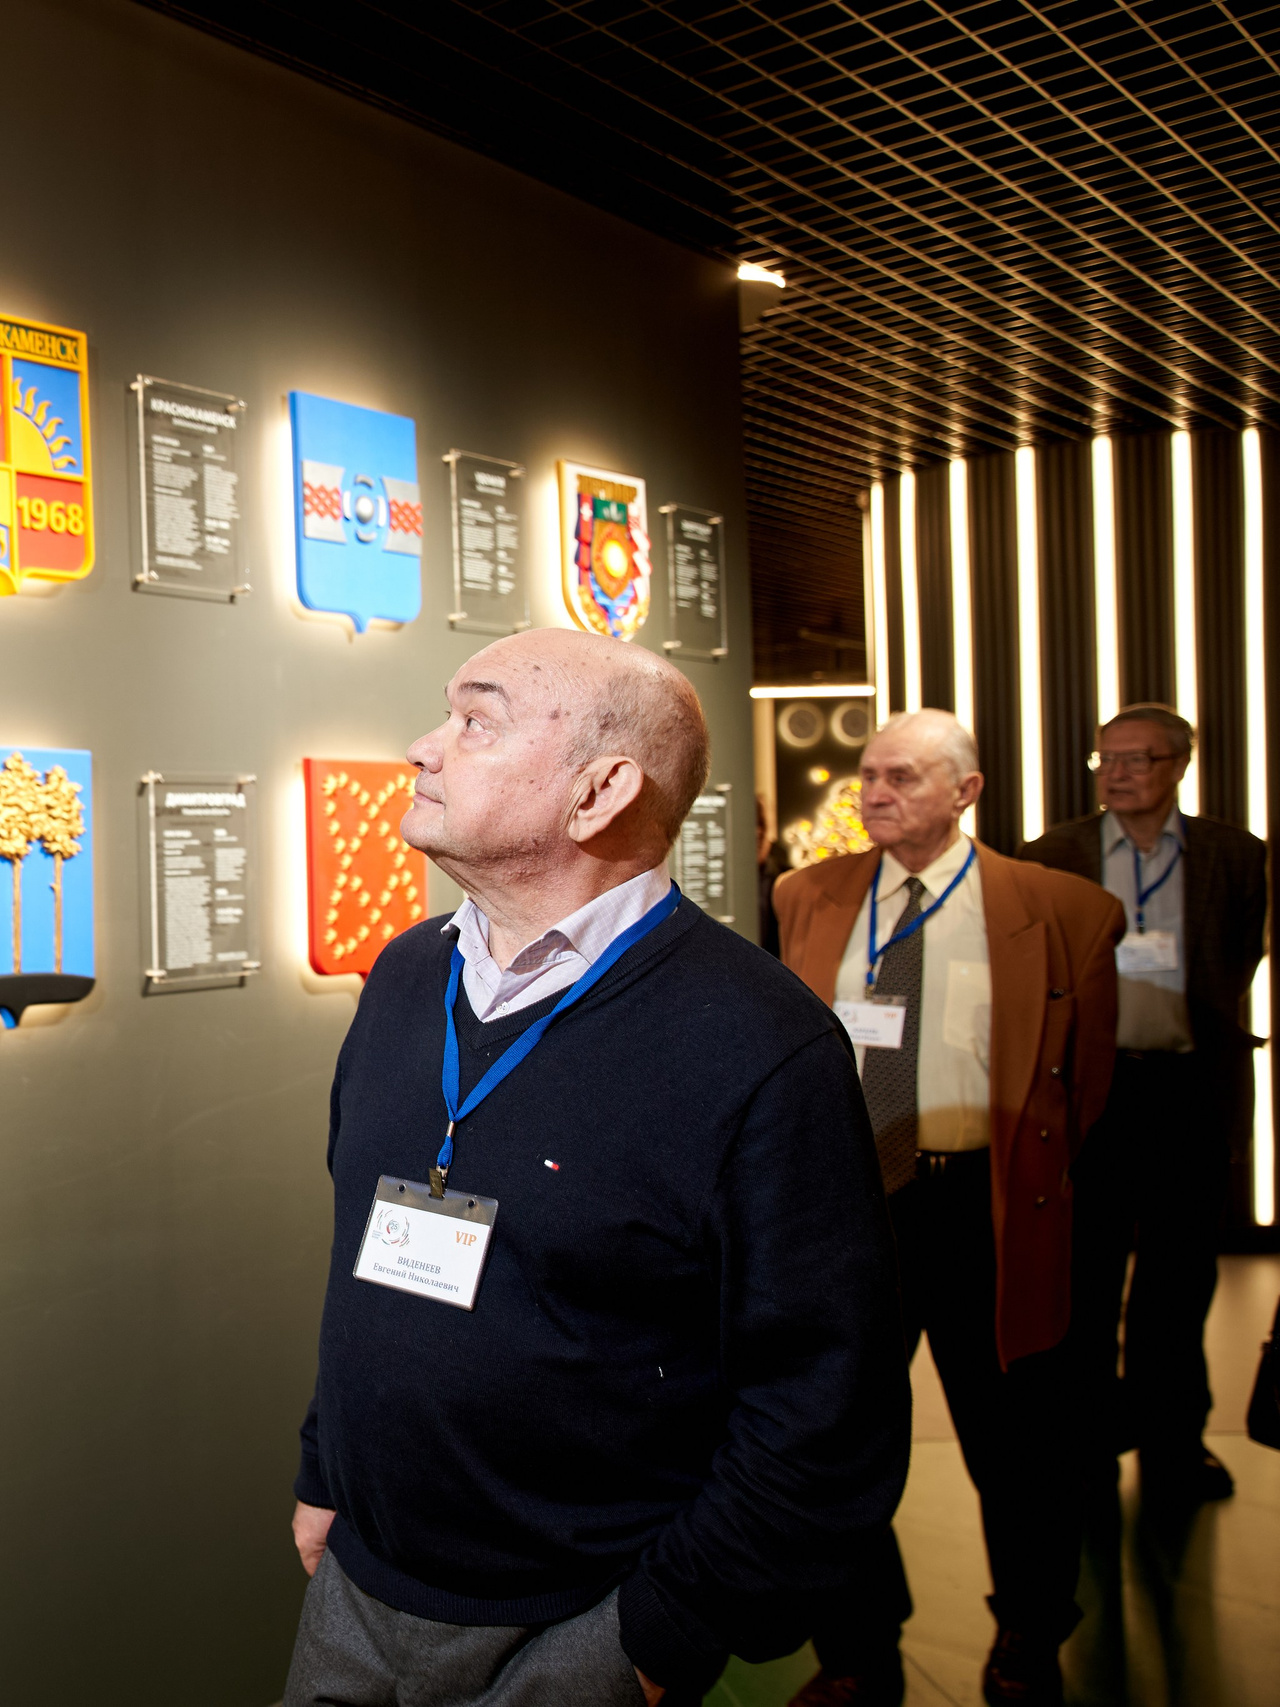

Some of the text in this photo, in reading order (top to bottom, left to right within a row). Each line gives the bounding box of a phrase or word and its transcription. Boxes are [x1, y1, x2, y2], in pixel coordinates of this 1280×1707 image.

[16, 495, 85, 536] 1968
[455, 1230, 477, 1247] VIP
[373, 1262, 459, 1292] Евгений Николаевич
[397, 1255, 442, 1275] ВИДЕНЕЕВ
